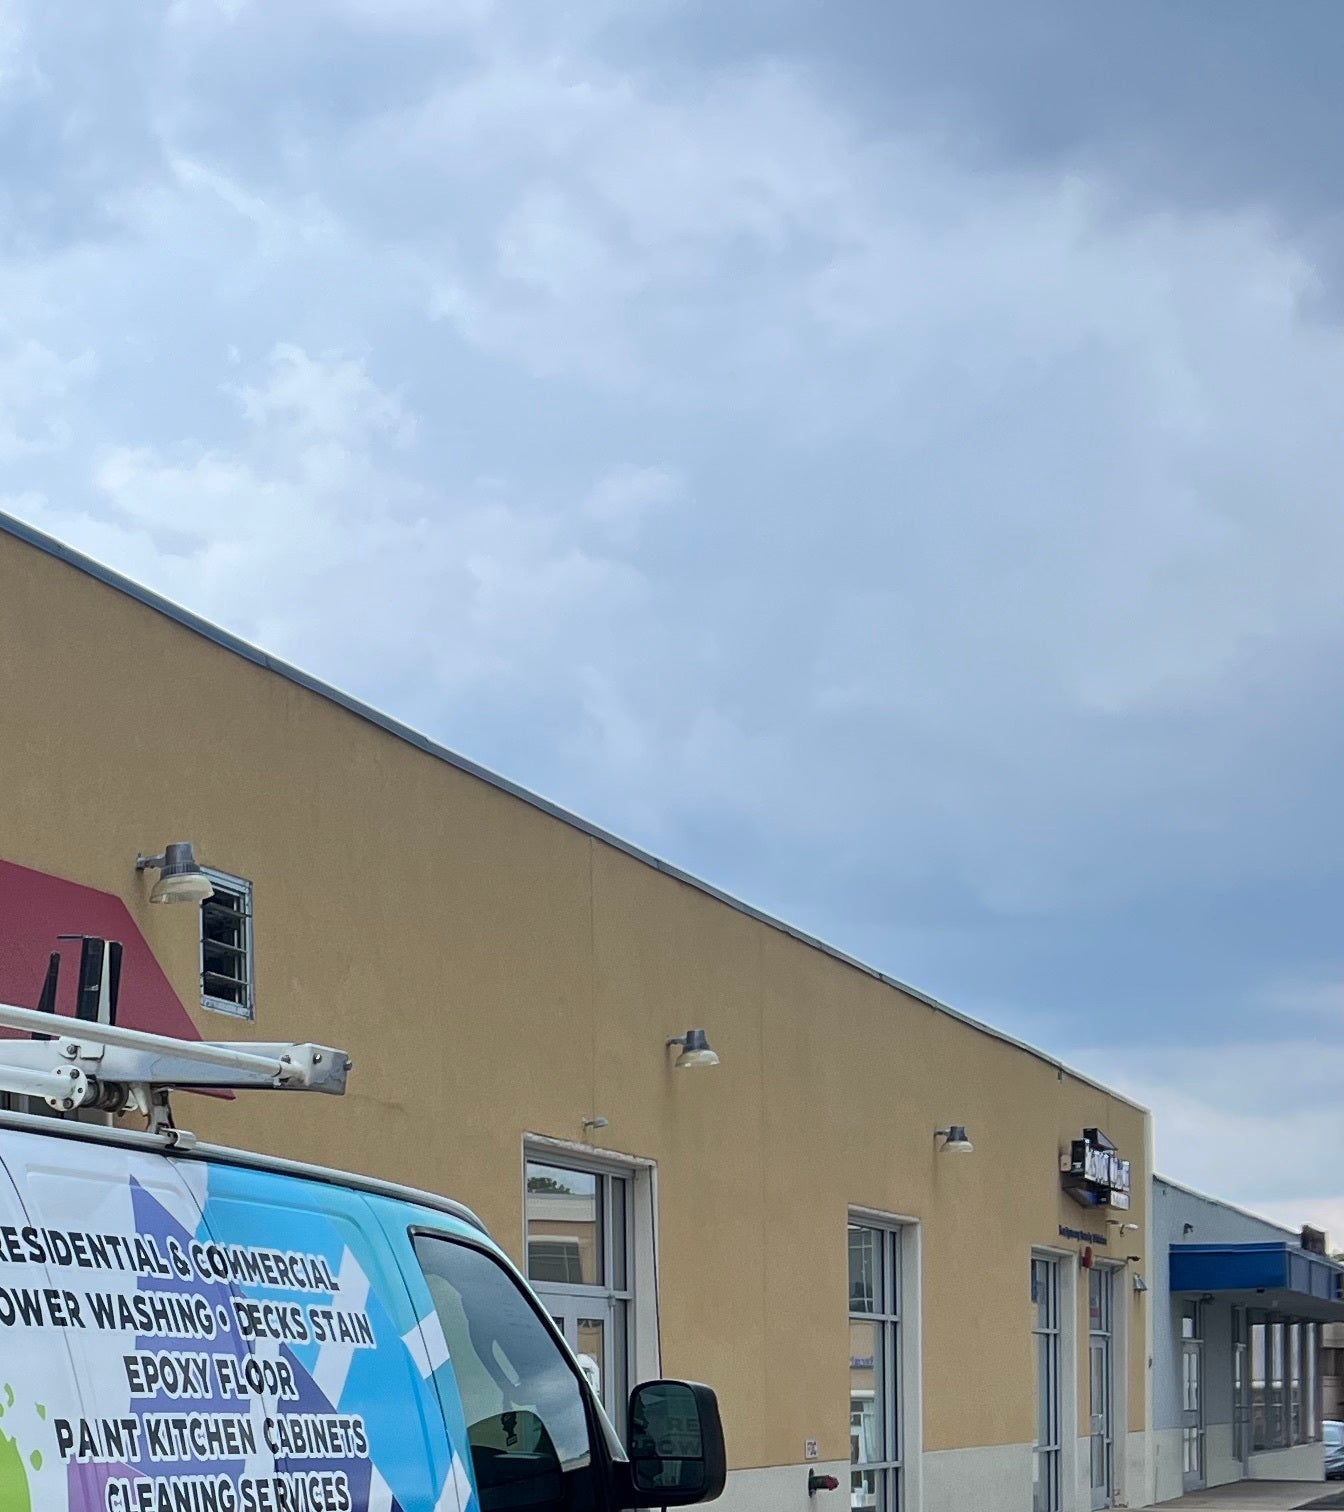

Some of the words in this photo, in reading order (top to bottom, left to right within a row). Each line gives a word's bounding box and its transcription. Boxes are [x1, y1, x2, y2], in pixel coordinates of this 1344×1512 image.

[169, 1238, 192, 1279] &
[191, 1242, 342, 1293] COMMERCIAL
[85, 1292, 214, 1336] WASHING
[236, 1302, 309, 1342] DECKS
[310, 1309, 376, 1347] STAIN
[123, 1354, 213, 1395] EPOXY
[215, 1357, 299, 1398] FLOOR
[54, 1417, 140, 1460] PAINT
[145, 1416, 257, 1457] KITCHEN
[263, 1416, 369, 1460] CABINETS
